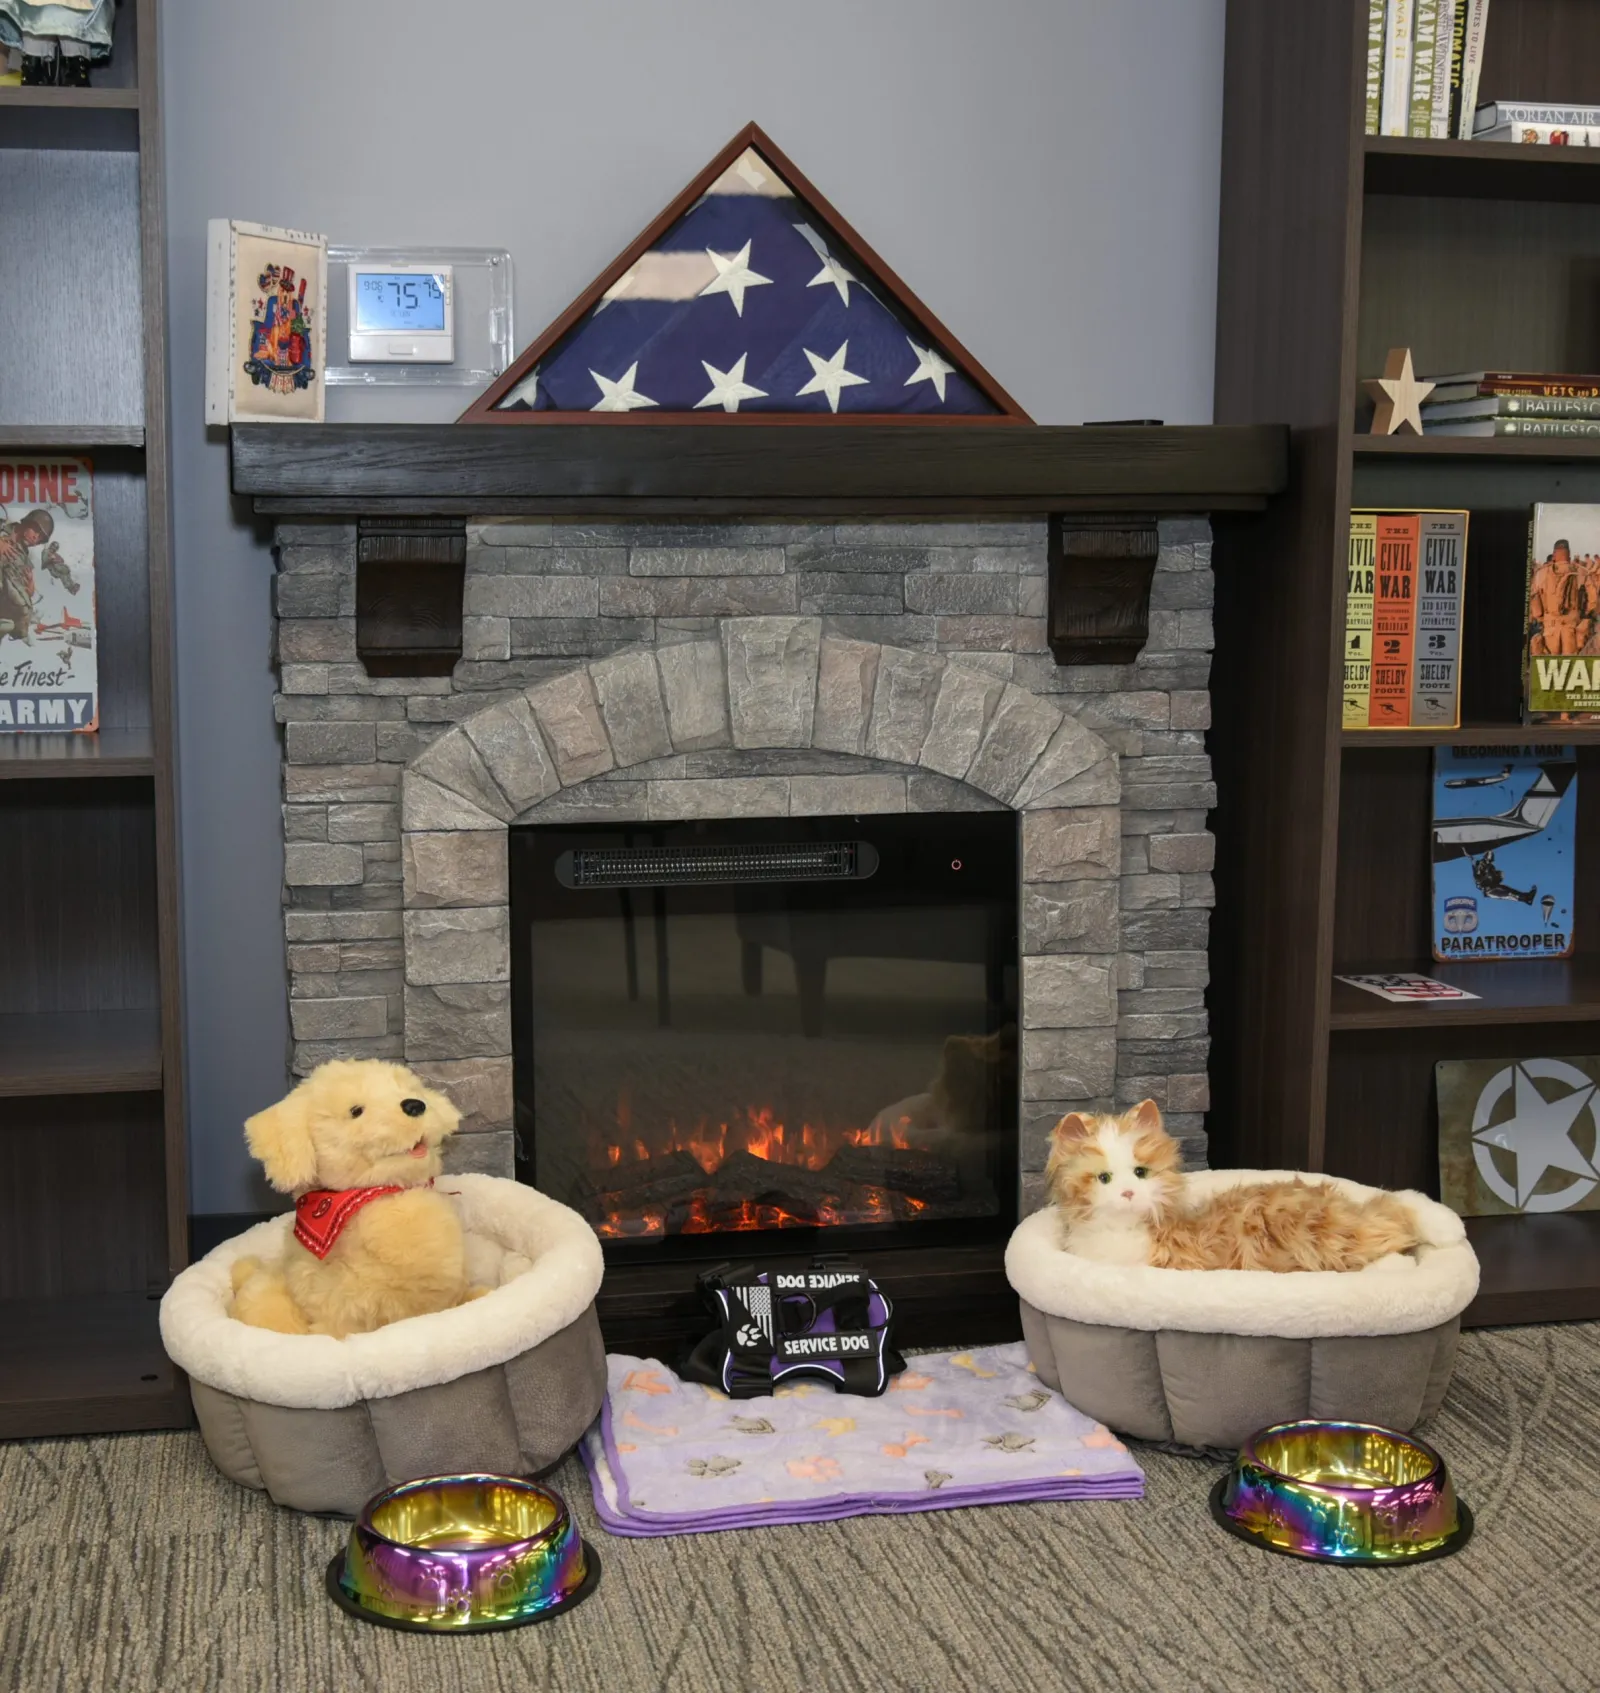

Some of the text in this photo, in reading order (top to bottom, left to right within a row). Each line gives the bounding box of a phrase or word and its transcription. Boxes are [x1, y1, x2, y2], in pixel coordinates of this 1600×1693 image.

[1471, 31, 1480, 43] TO
[1468, 45, 1478, 64] LIVE
[1366, 47, 1381, 99] WAR
[1412, 48, 1433, 101] WAR
[1432, 33, 1449, 103] WINTER
[1504, 108, 1597, 125] KOREAN AIR
[387, 281, 442, 310] 75 75
[0, 464, 79, 503] ORNE
[1380, 543, 1412, 572] CIVIL
[1426, 538, 1458, 567] CIVIL
[1379, 575, 1411, 599] WAR
[1425, 570, 1457, 594] WAR
[1347, 635, 1361, 649] 1
[1383, 639, 1401, 654] 2
[1428, 634, 1446, 649] 3
[1375, 669, 1407, 685] SHELBY
[1420, 664, 1452, 681] SHELBY
[0, 699, 88, 724] ARMY
[1441, 933, 1565, 951] PARATROOPER
[776, 1274, 806, 1288] DOG
[784, 1335, 870, 1354] SERVICE DOG
